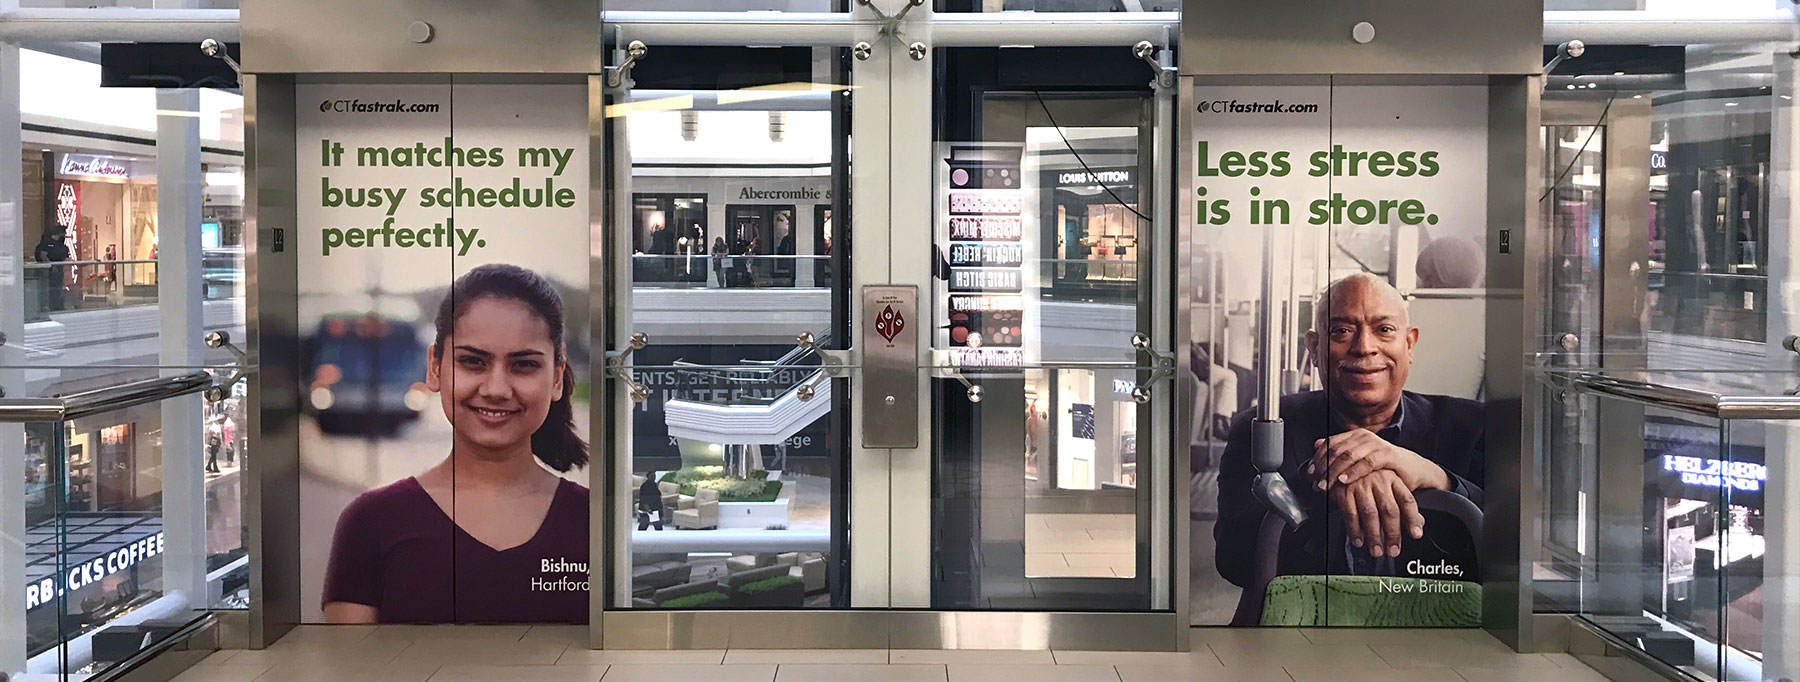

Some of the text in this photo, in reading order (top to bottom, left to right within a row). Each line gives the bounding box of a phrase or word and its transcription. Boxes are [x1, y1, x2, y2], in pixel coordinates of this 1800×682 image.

[333, 99, 439, 113] CTfastrak.com
[1211, 99, 1318, 113] CTfastrak.com
[322, 137, 575, 176] It matches my
[1197, 141, 1440, 177] Less stress
[1651, 153, 1667, 169] Co.
[1059, 172, 1087, 184] LOUIS
[322, 177, 575, 216] busy schedule
[739, 186, 821, 200] Abercrombie
[1197, 186, 1439, 226] is in store.
[322, 217, 487, 257] perfectly.
[1682, 472, 1760, 491] DIAMONDS
[107, 532, 163, 574] COFFEE
[541, 557, 590, 575] Bishnu,
[1406, 559, 1464, 577] Charles,
[531, 575, 590, 591] Hartford
[1379, 579, 1463, 593] New Britain
